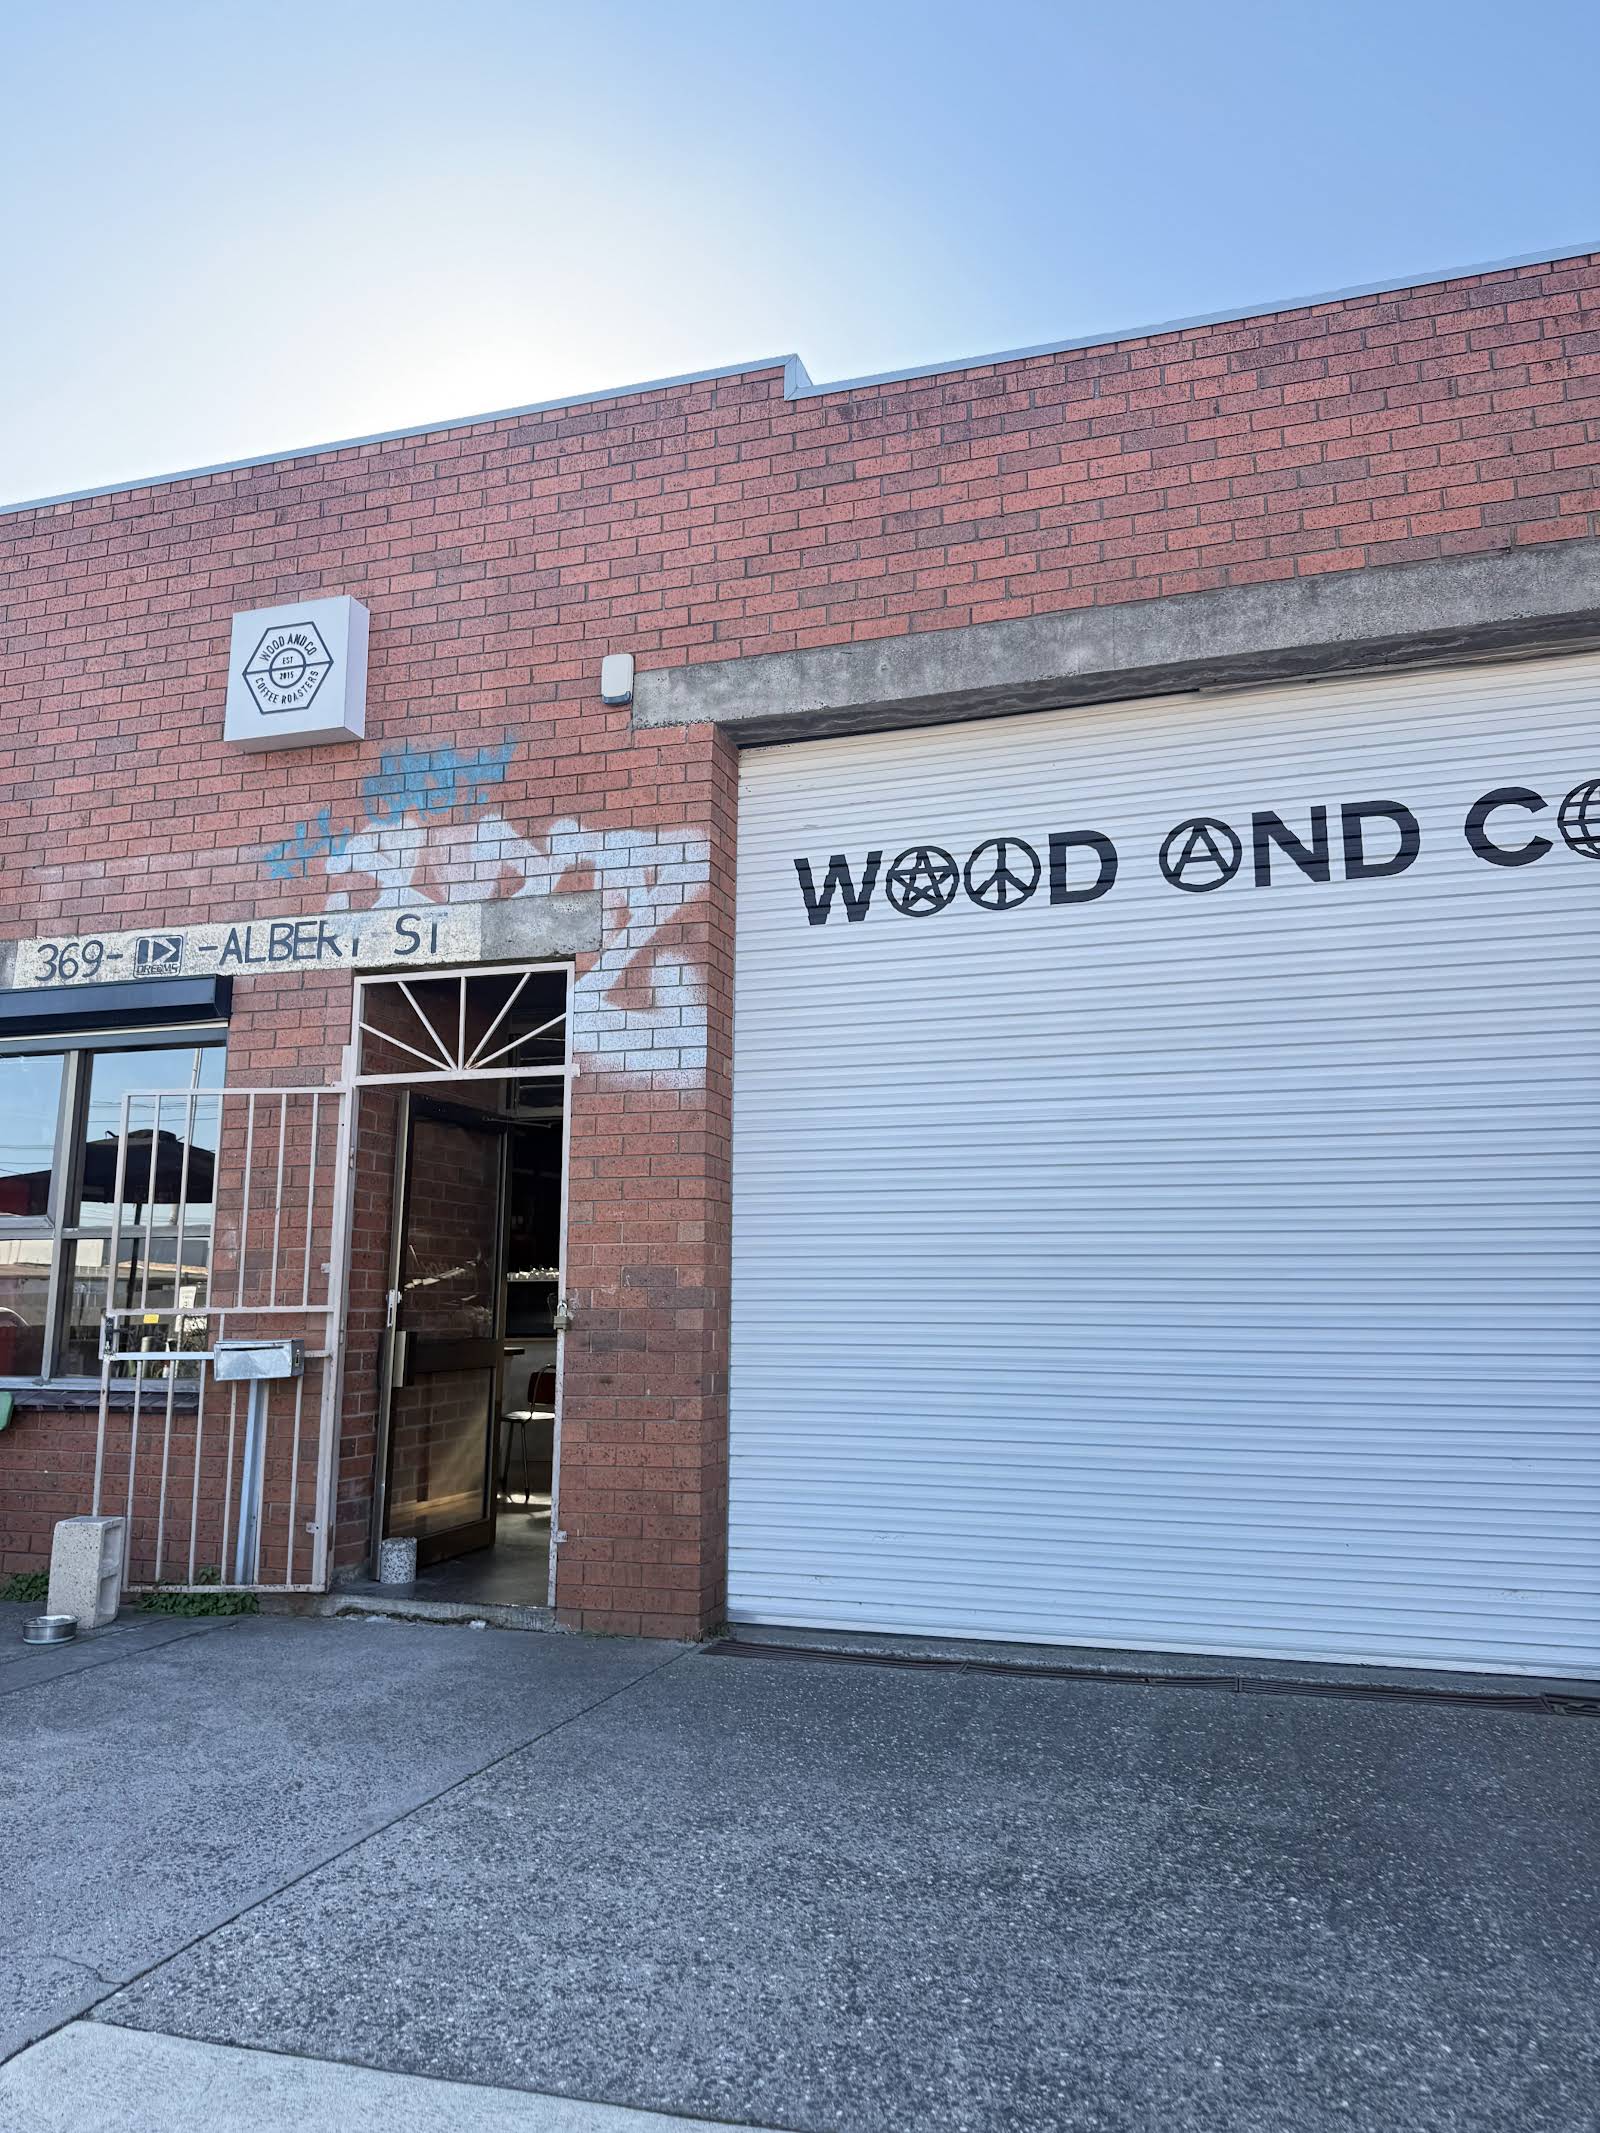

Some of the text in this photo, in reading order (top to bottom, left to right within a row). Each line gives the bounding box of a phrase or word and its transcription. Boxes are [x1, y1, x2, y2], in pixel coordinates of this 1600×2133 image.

[259, 633, 317, 662] WOOD AND CO
[282, 656, 293, 665] EST
[255, 670, 319, 704] COFFEE ROASTERS
[279, 671, 294, 680] 2015
[1159, 800, 1421, 892] AND
[394, 911, 448, 956] ST
